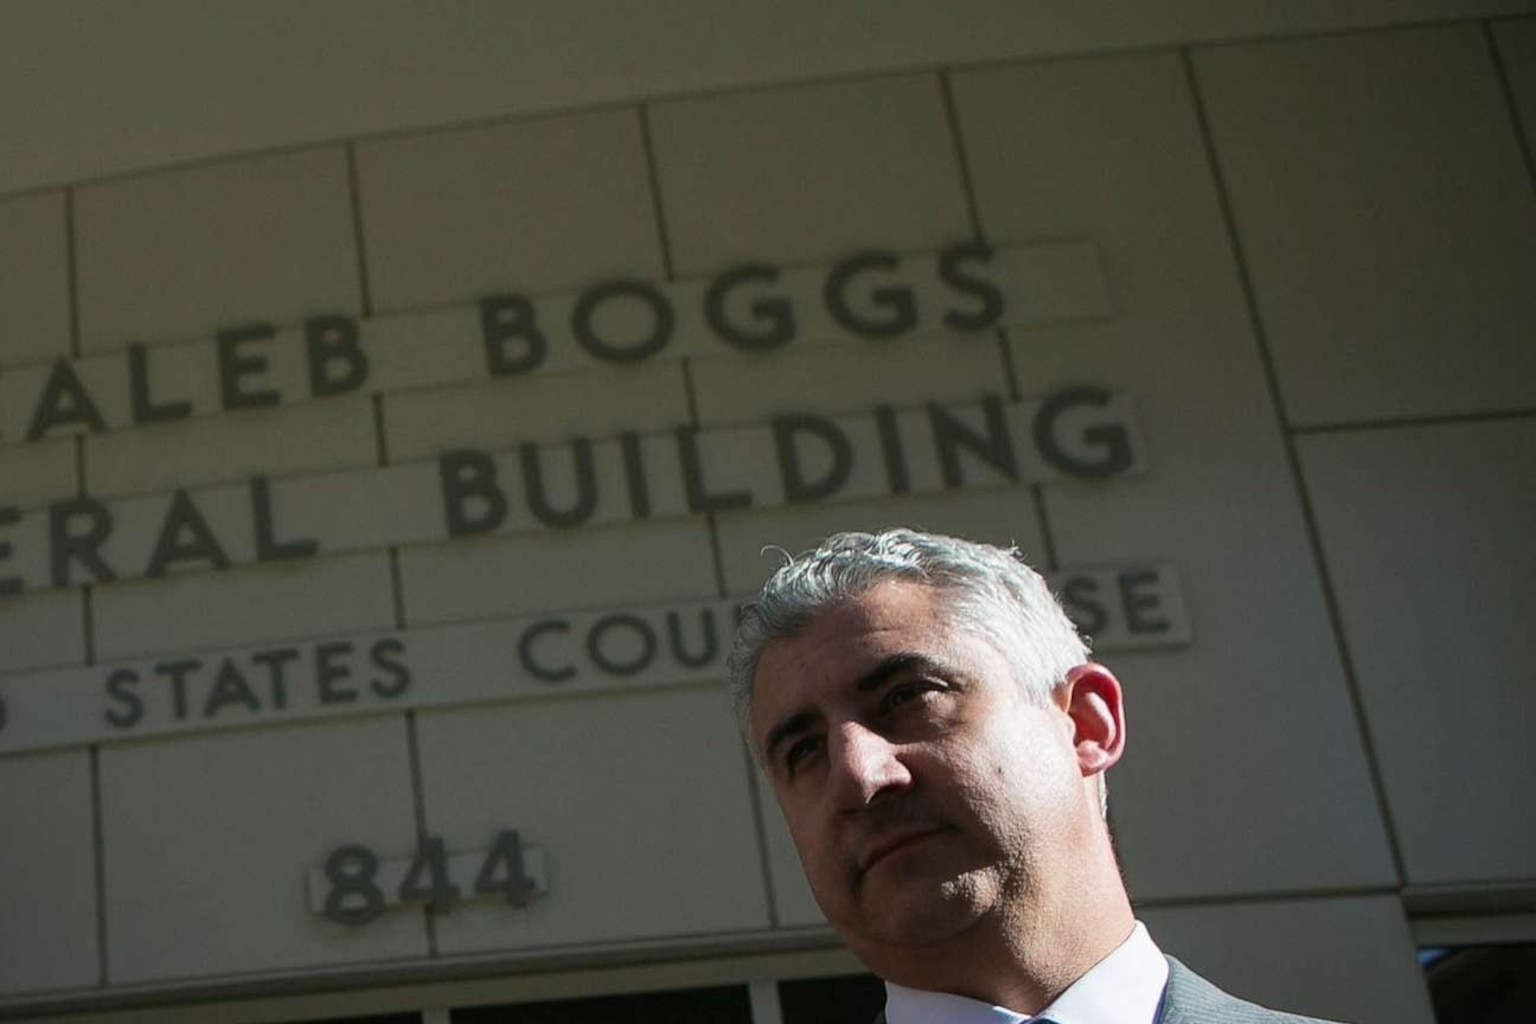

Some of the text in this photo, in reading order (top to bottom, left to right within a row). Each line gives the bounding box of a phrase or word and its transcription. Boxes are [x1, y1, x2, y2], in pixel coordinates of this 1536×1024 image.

[479, 241, 1006, 379] BOGGS
[438, 385, 1135, 538] BUILDING
[103, 637, 413, 729] STATES
[323, 828, 538, 928] 844
